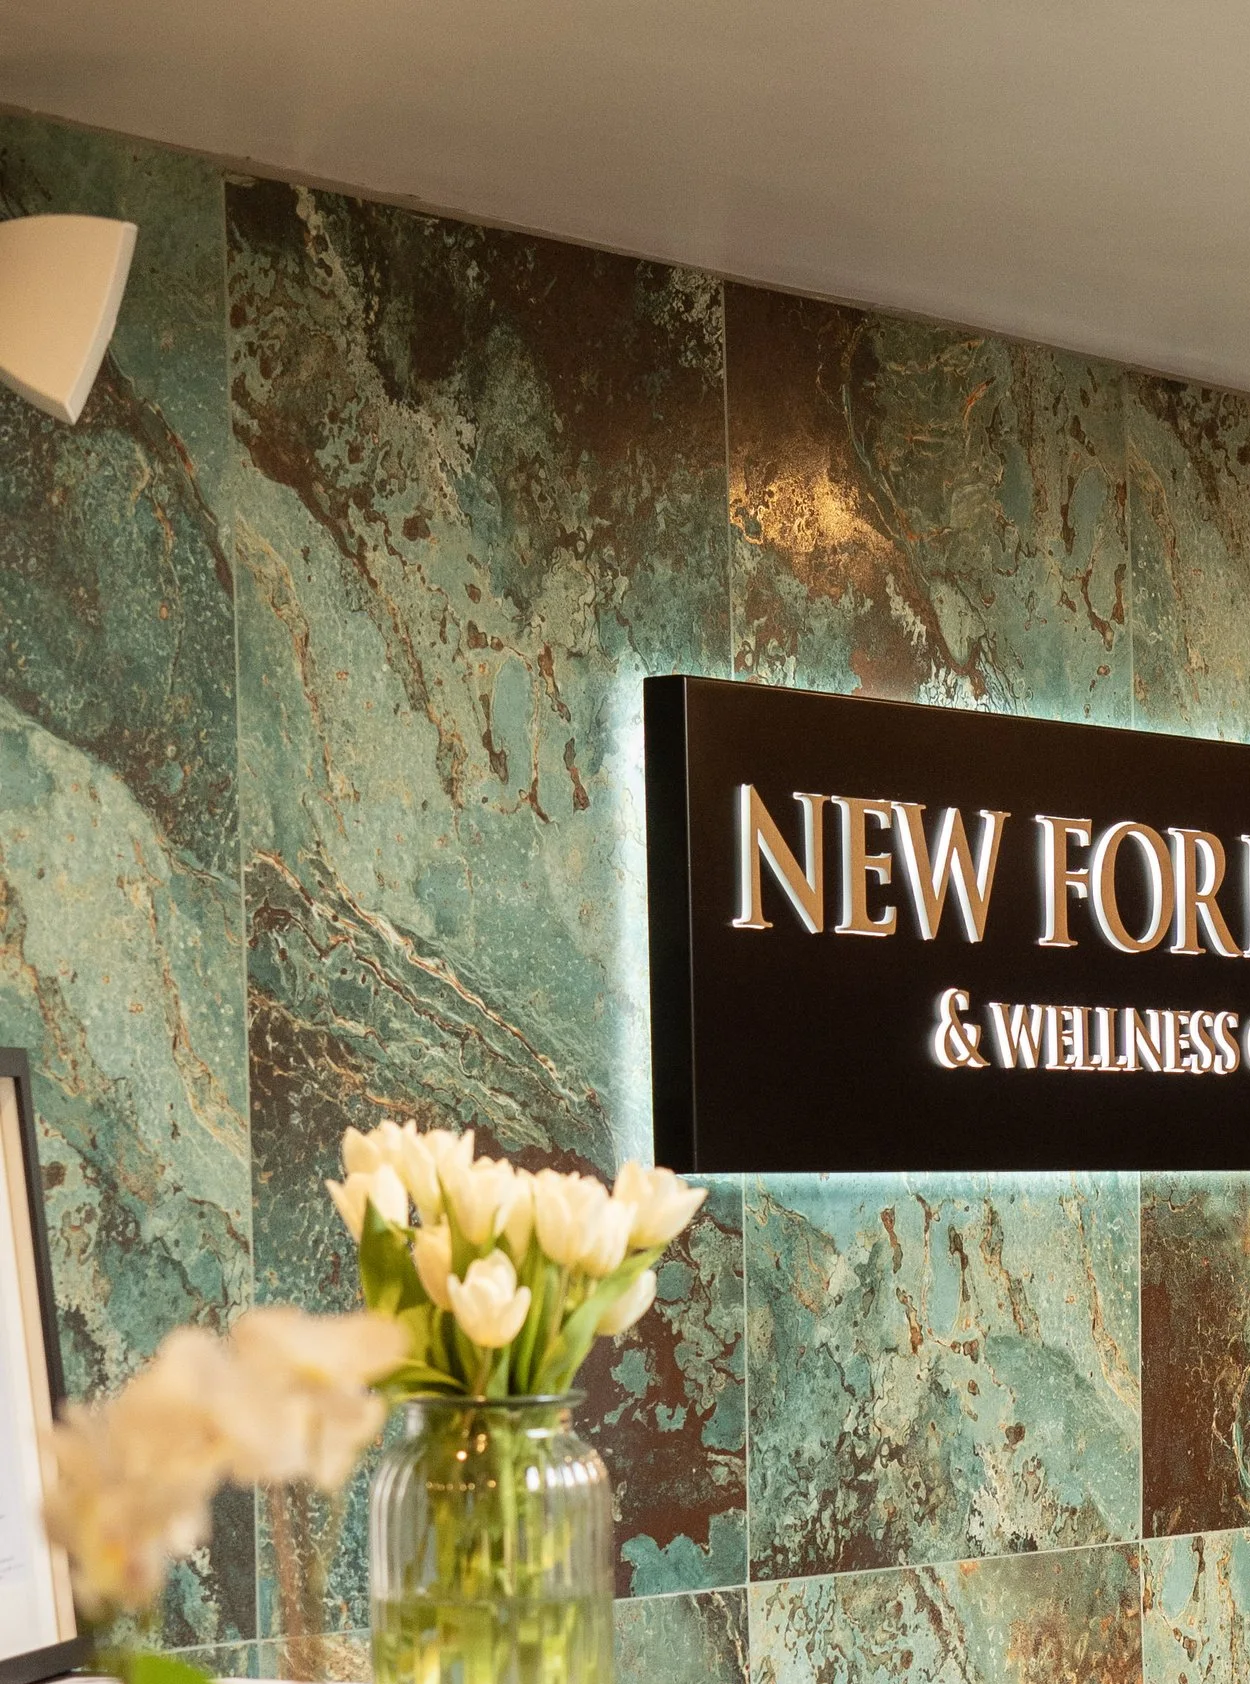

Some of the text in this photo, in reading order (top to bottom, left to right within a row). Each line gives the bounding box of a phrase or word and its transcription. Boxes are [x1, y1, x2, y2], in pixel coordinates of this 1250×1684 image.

[731, 784, 1011, 943] NEW
[932, 987, 988, 1070] &
[989, 1002, 1240, 1076] WELLNESS
